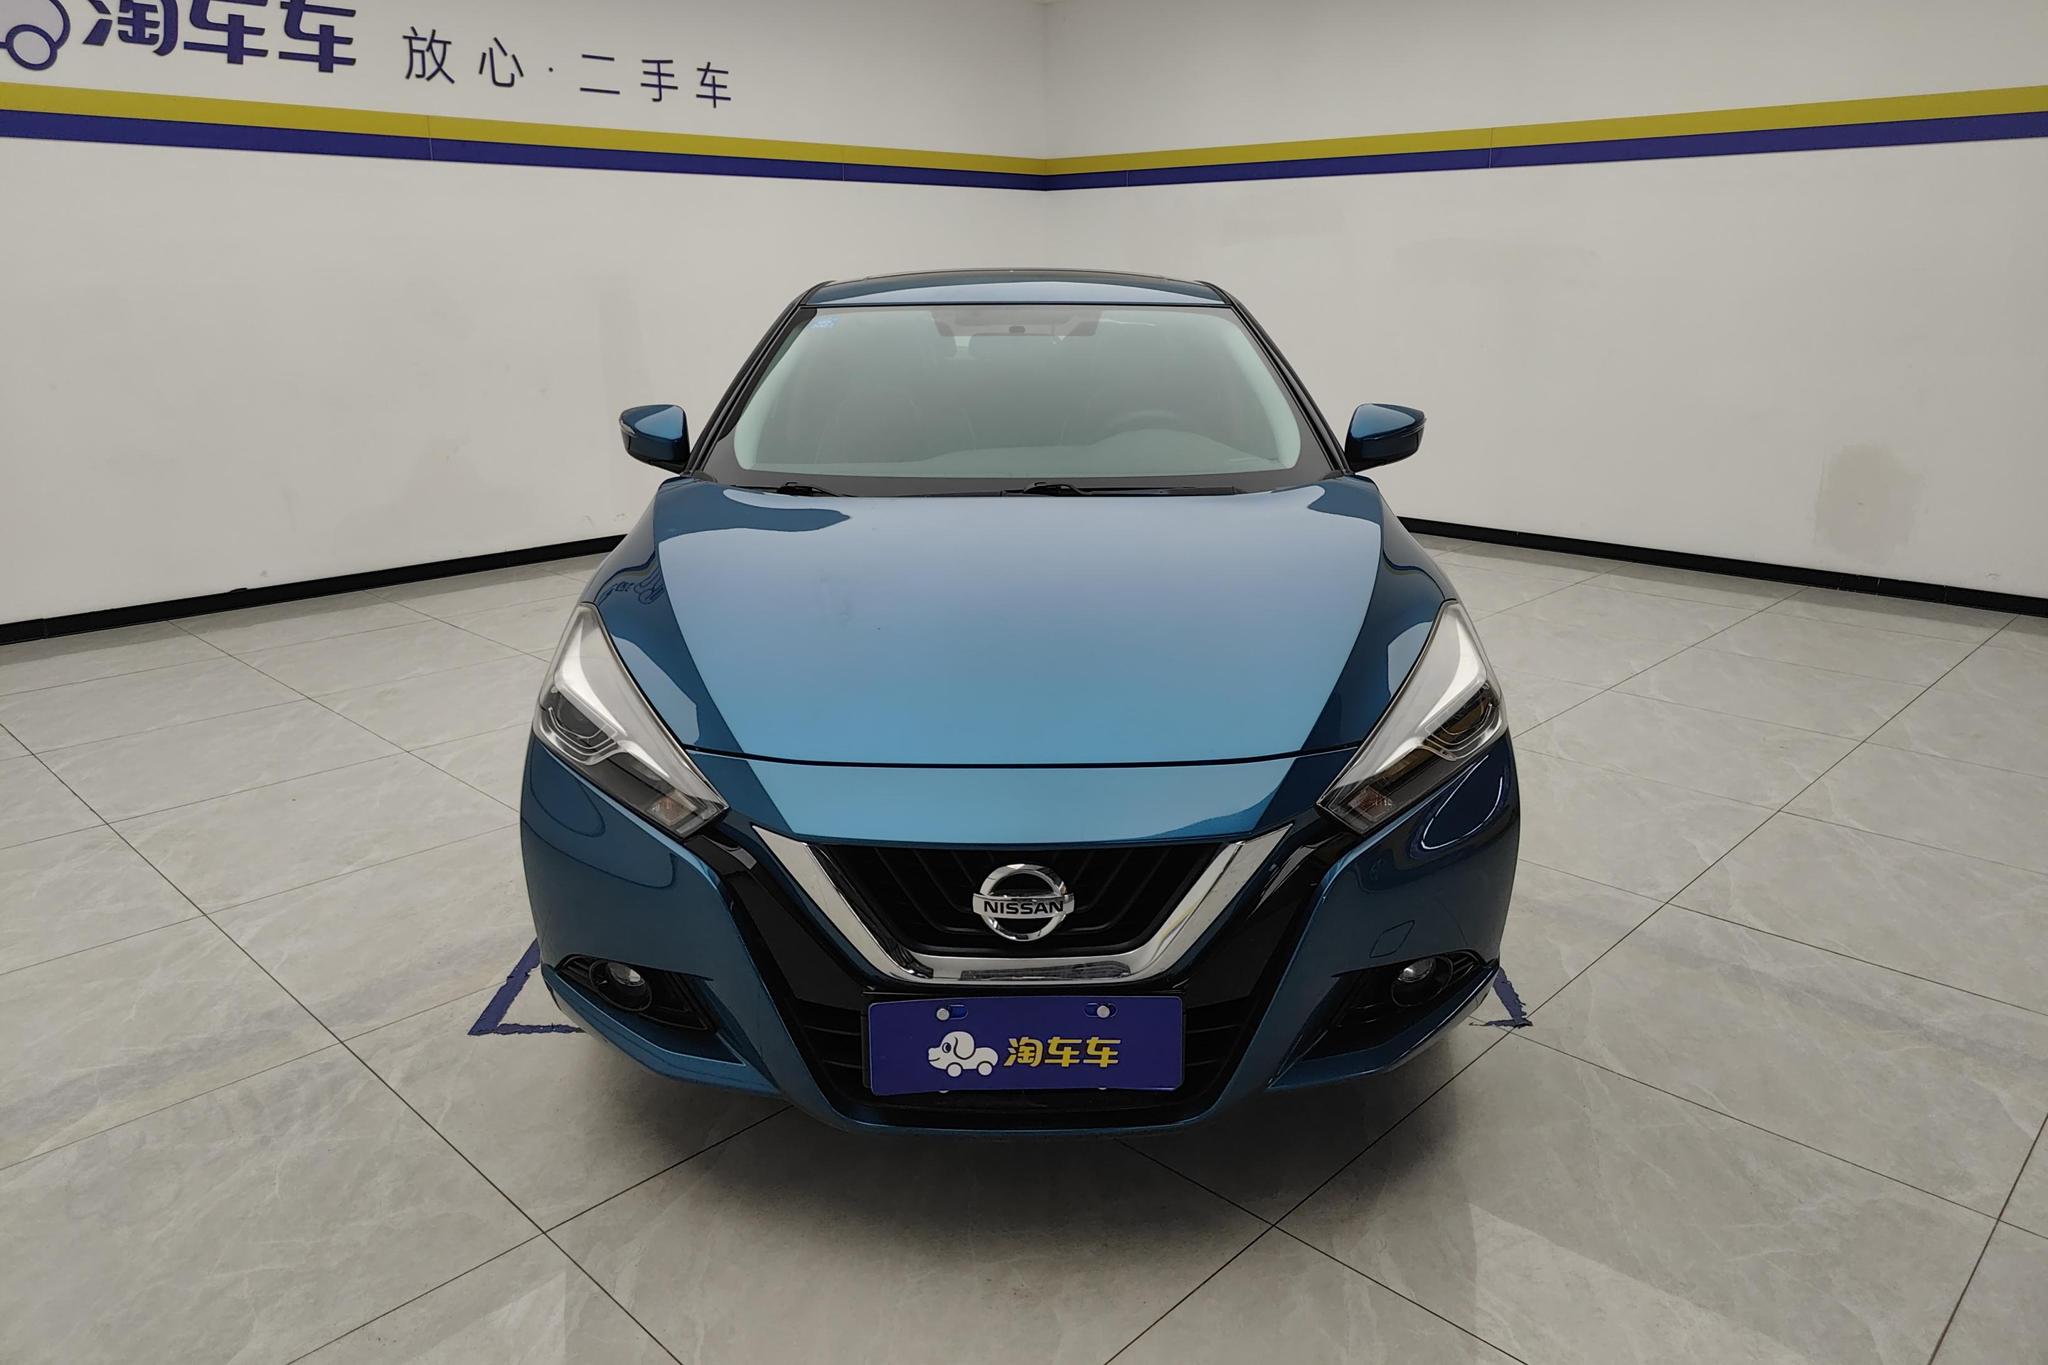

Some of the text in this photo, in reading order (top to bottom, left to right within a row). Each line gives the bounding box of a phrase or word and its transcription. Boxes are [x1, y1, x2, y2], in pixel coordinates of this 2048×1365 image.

[984, 901, 1064, 914] NISSAN
[1003, 1036, 1121, 1068] 淘车车
